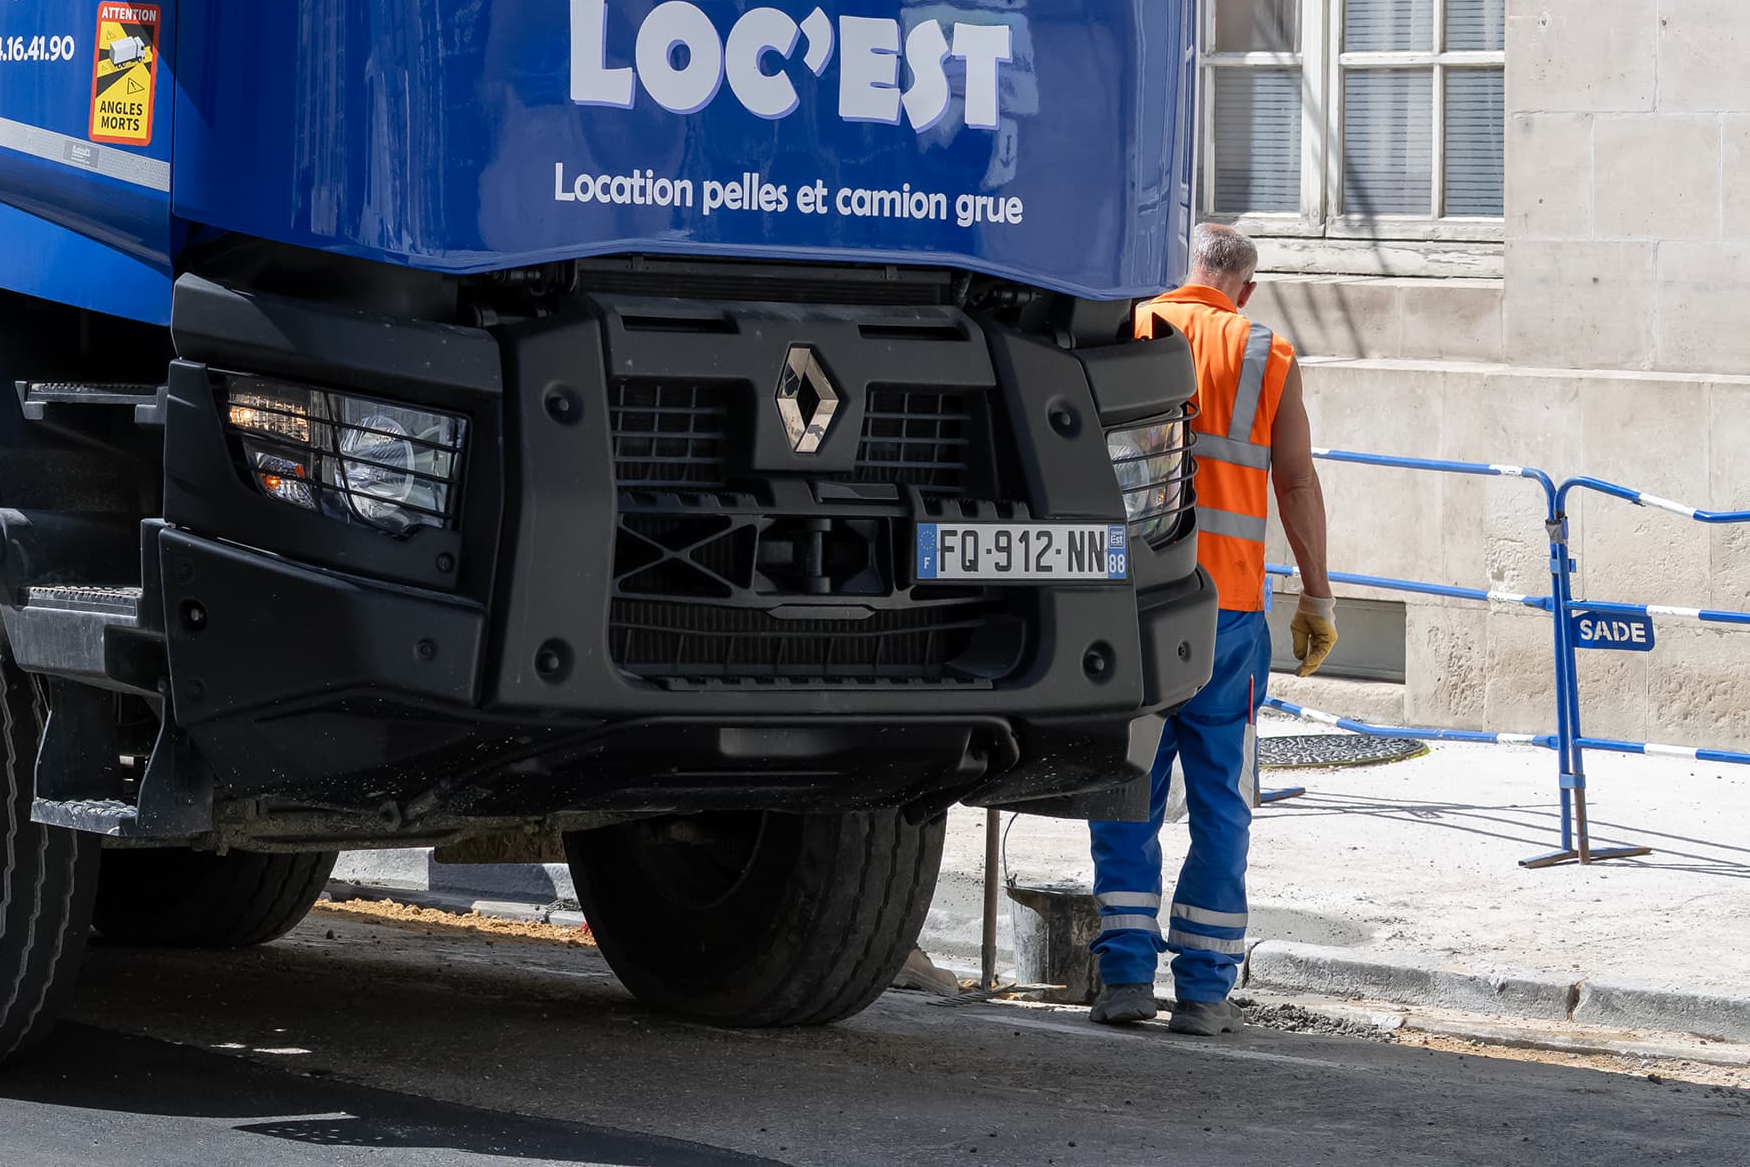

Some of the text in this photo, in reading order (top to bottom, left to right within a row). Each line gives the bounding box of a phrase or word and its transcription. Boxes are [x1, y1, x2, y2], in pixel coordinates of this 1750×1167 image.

[102, 6, 157, 22] ATTENTION
[100, 100, 143, 116] ANGLES
[101, 116, 140, 132] MORTS
[554, 162, 1024, 228] Location pelles et camion grue
[923, 556, 931, 570] F
[1109, 553, 1126, 574] 88
[1579, 619, 1647, 644] SADE
